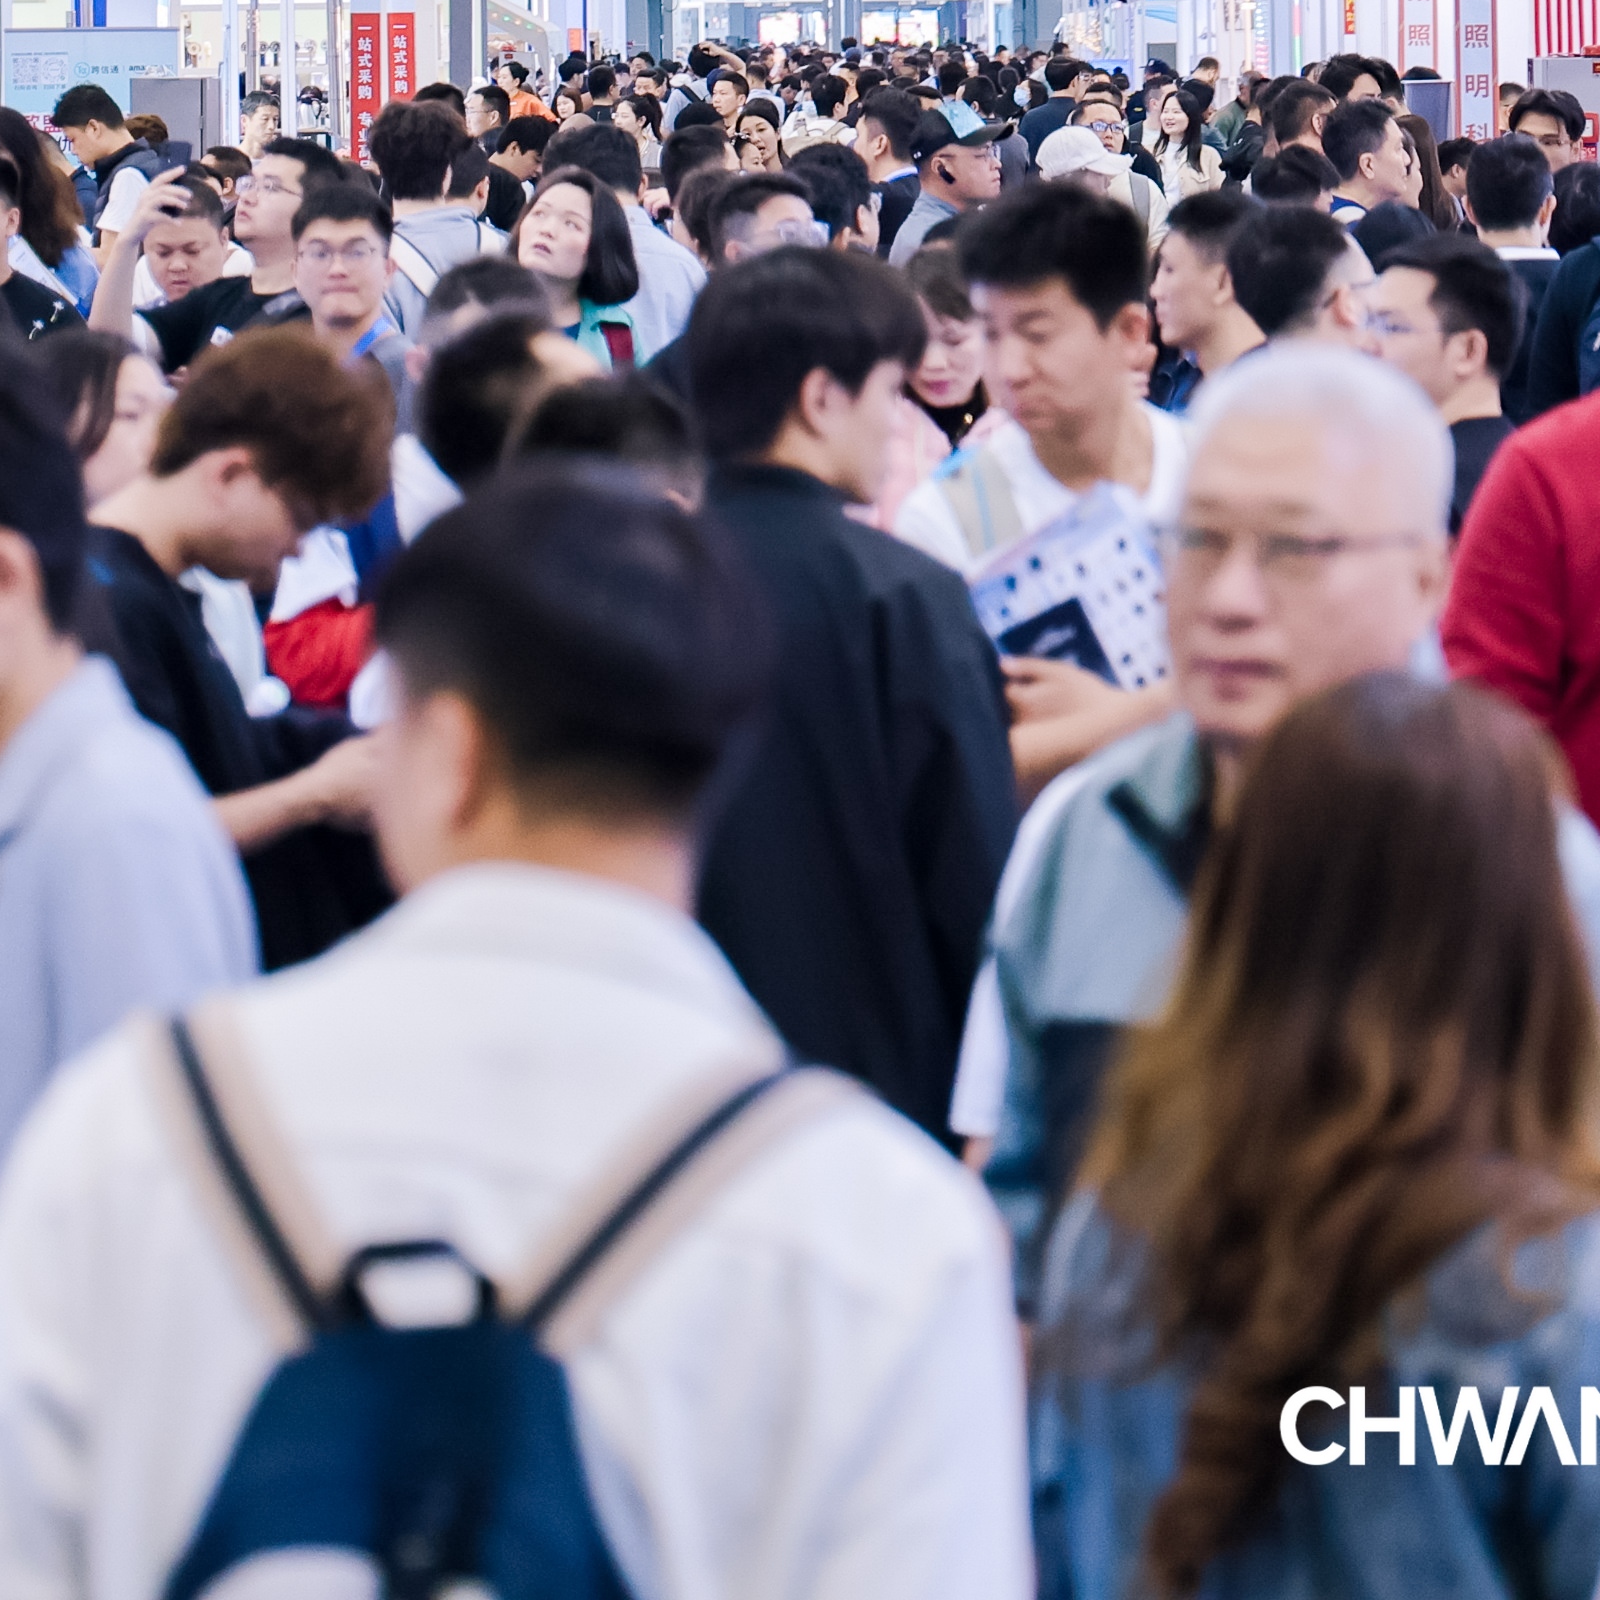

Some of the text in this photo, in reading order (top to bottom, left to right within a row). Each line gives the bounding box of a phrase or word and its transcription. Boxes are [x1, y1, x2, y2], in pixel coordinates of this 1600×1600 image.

[357, 26, 373, 100] 一站式采购
[392, 24, 408, 94] 一站式采购
